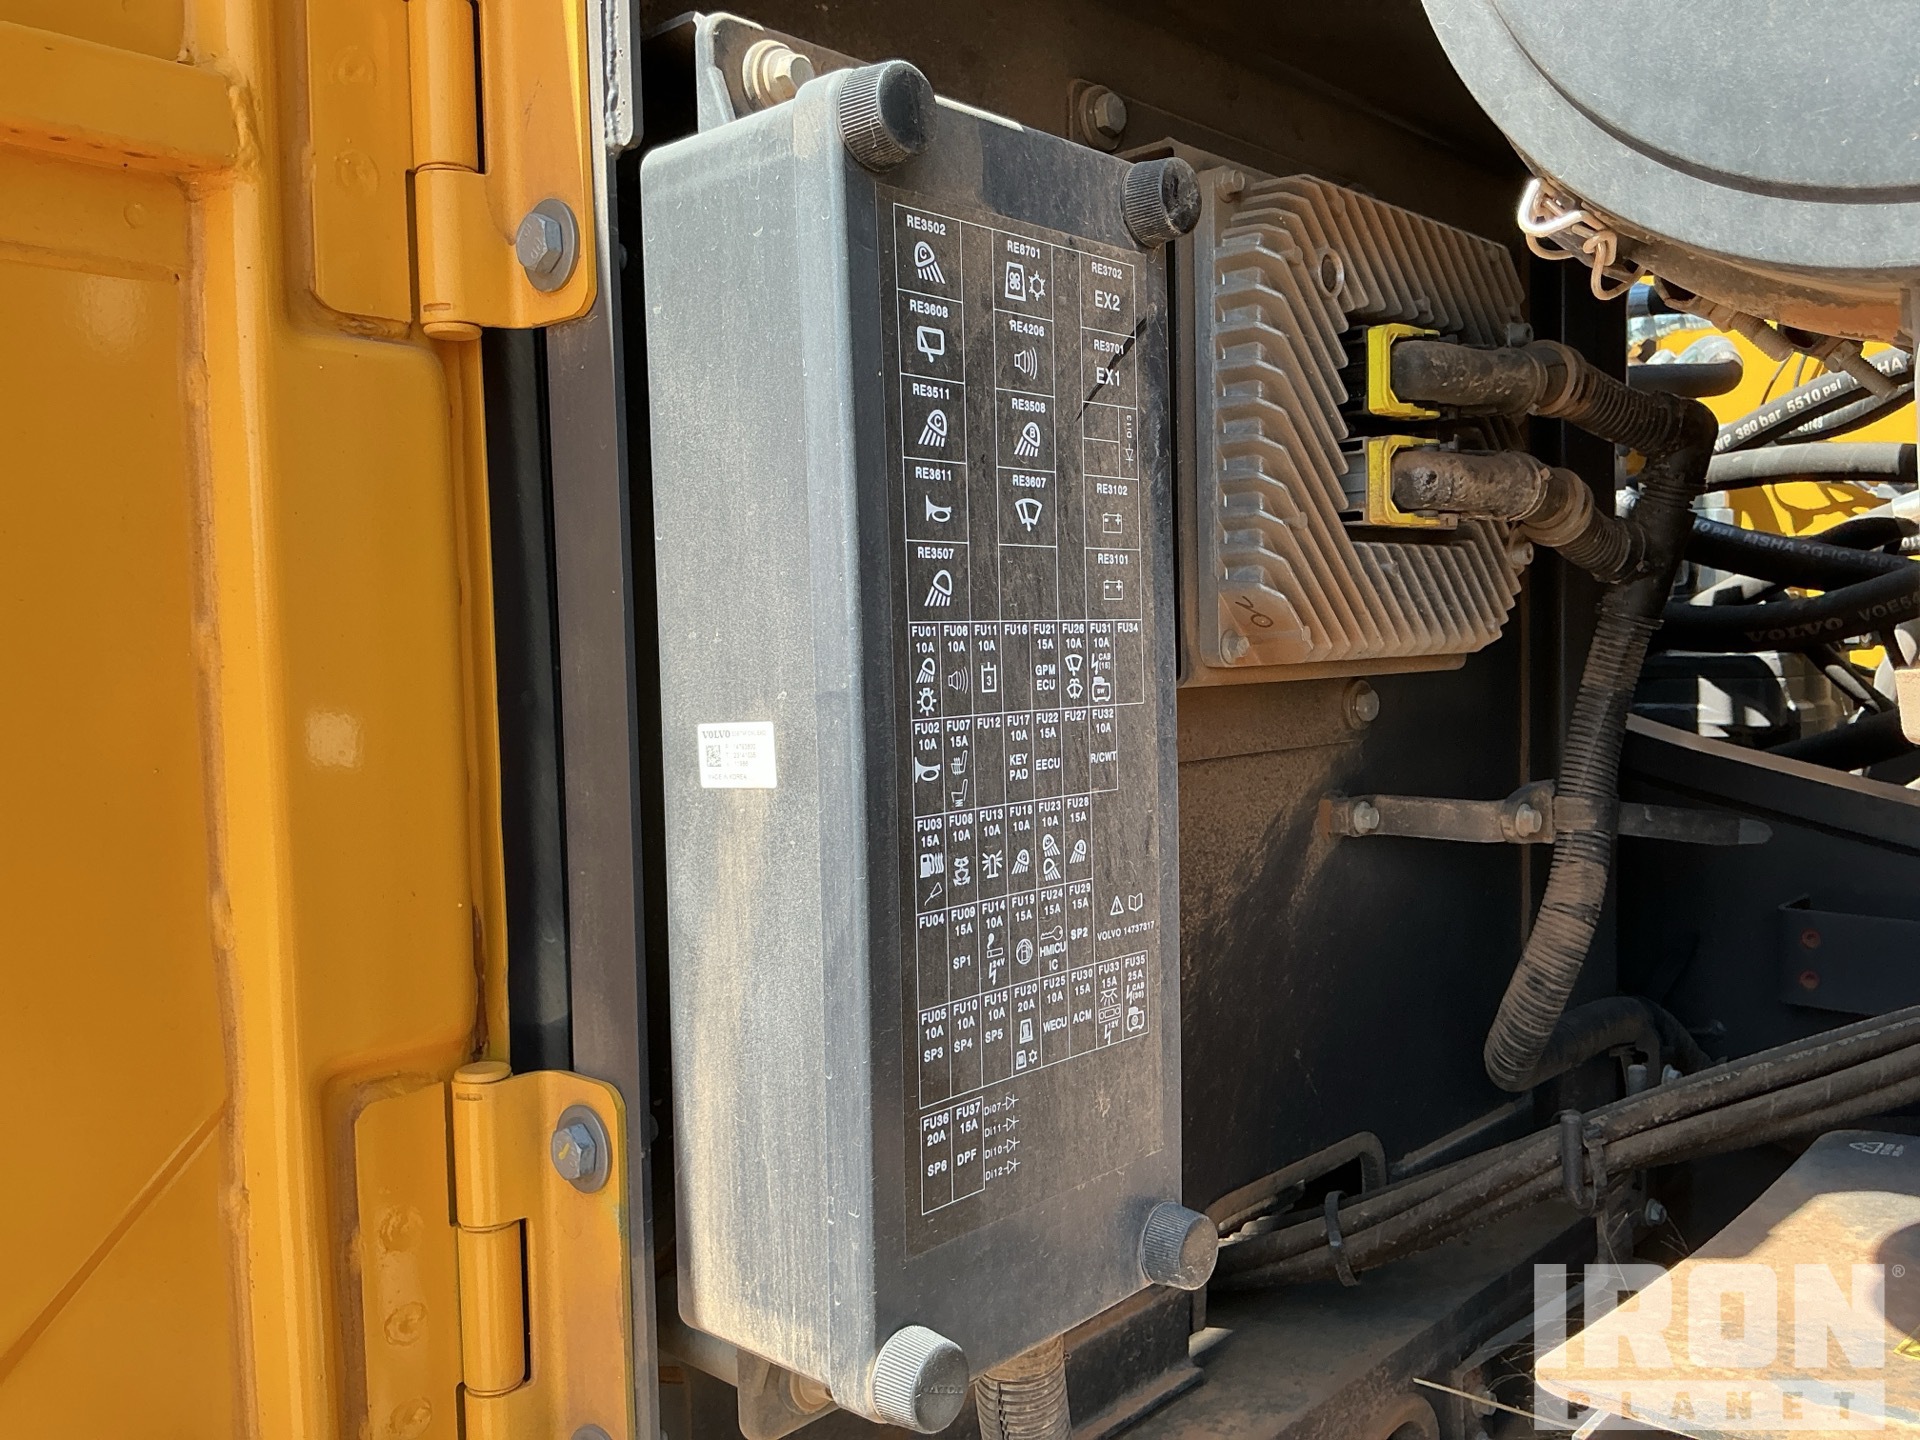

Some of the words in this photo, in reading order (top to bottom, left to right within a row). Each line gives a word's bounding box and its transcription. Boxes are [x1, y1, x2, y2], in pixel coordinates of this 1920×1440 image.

[907, 214, 946, 235] RE3502
[1007, 240, 1040, 259] RE8701
[1091, 262, 1122, 280] RE3702
[1095, 290, 1120, 311] EX2
[910, 299, 948, 318] RE3608
[1010, 320, 1044, 337] RE4206
[1094, 339, 1124, 355] RE3701
[1097, 367, 1120, 386] EX1
[912, 383, 950, 400] RE3511
[1012, 398, 1046, 413] RE3508
[1735, 419, 1758, 440] 380
[1758, 408, 1781, 427] bar
[1786, 389, 1821, 414] 5510
[915, 467, 951, 481] RE3611
[1012, 475, 1046, 488] RE3607
[1097, 483, 1127, 495] RE3102
[1744, 530, 1794, 551] MSHA
[917, 547, 954, 560] RE3507
[1098, 554, 1128, 564] RE3101
[912, 626, 936, 637] FU01
[975, 625, 996, 636] FU11
[1034, 624, 1055, 634] FU21
[1090, 623, 1110, 633] FU31
[1118, 623, 1138, 632] FU34
[1745, 617, 1844, 642] VOLVO
[916, 642, 934, 653] 10A
[948, 641, 965, 652] 10A
[979, 640, 995, 651] 10A
[1037, 639, 1053, 649] 15A
[1066, 638, 1082, 648] 10A
[1094, 637, 1110, 647] 10A
[1035, 664, 1055, 675] GPM
[1037, 679, 1055, 690] ECU
[1008, 714, 1030, 726] FU17
[1036, 712, 1058, 724] FU22
[1065, 710, 1086, 721] FU27
[1092, 709, 1113, 719] FU32
[915, 722, 939, 734] FU02
[947, 720, 970, 732] FU07
[977, 717, 1000, 729] FU12
[1096, 723, 1111, 733] 10A
[702, 730, 730, 738] VOLVO
[1011, 730, 1028, 741] 10A
[1040, 727, 1056, 738] 15A
[919, 738, 937, 750] 10A
[951, 735, 968, 747] 15A
[1010, 753, 1028, 766] KEY
[1090, 751, 1116, 763] R/CWT
[1036, 758, 1060, 770] EECU
[1010, 769, 1028, 781] PAD
[1039, 801, 1060, 813] FU23
[1067, 797, 1089, 809] FU28
[980, 809, 1003, 822] FU13
[1010, 805, 1032, 817] FU18
[1070, 811, 1086, 822] 15A
[917, 818, 942, 832] FU03
[949, 813, 972, 827] FU08
[1013, 820, 1030, 831] 10A
[1042, 815, 1058, 827] 10A
[953, 829, 970, 842] 10A
[984, 824, 1000, 837] 10A
[921, 834, 939, 848] 15A
[1041, 889, 1063, 902] FU24
[1069, 883, 1090, 896] FU29
[982, 900, 1005, 915] FU14
[1012, 894, 1034, 908] FU19
[1072, 898, 1088, 910] 15A
[951, 907, 975, 922] FU09
[1016, 910, 1032, 922] 15A
[1045, 903, 1060, 916] 15A
[920, 913, 944, 929] FU04
[986, 915, 1003, 929] 10A
[955, 922, 973, 936] 15A
[1071, 927, 1088, 940] SP2
[1097, 928, 1121, 941] VOLVO
[953, 955, 970, 969] SP1
[992, 958, 1005, 968] 24V
[1049, 959, 1058, 971] IC
[1125, 954, 1145, 968] FU35
[1072, 968, 1092, 982] FU30
[1099, 962, 1119, 975] FU33
[1102, 976, 1117, 988] 15A
[1128, 970, 1143, 981] 25A
[1044, 976, 1065, 990] FU25
[1075, 983, 1090, 996] 15A
[1132, 982, 1144, 990] CAB
[1015, 983, 1037, 998] FU20
[985, 991, 1008, 1007] FU15
[1047, 991, 1063, 1004] 10A
[954, 999, 977, 1016] FU10
[1018, 999, 1035, 1012] 20A
[922, 1008, 946, 1025] FU05
[989, 1007, 1005, 1021] 10A
[1073, 1009, 1092, 1024] ACM
[958, 1016, 975, 1030] 10A
[1043, 1016, 1067, 1032] WECU
[926, 1025, 944, 1040] 10A
[985, 1028, 1003, 1043] SP5
[954, 1038, 972, 1053] SP4
[924, 1047, 943, 1062] SP3
[956, 1102, 980, 1120] FU37
[923, 1112, 949, 1131] FU36
[961, 1118, 978, 1134] 15A
[927, 1130, 946, 1146] 20A
[957, 1149, 976, 1166] DPF
[928, 1160, 947, 1176] SP6
